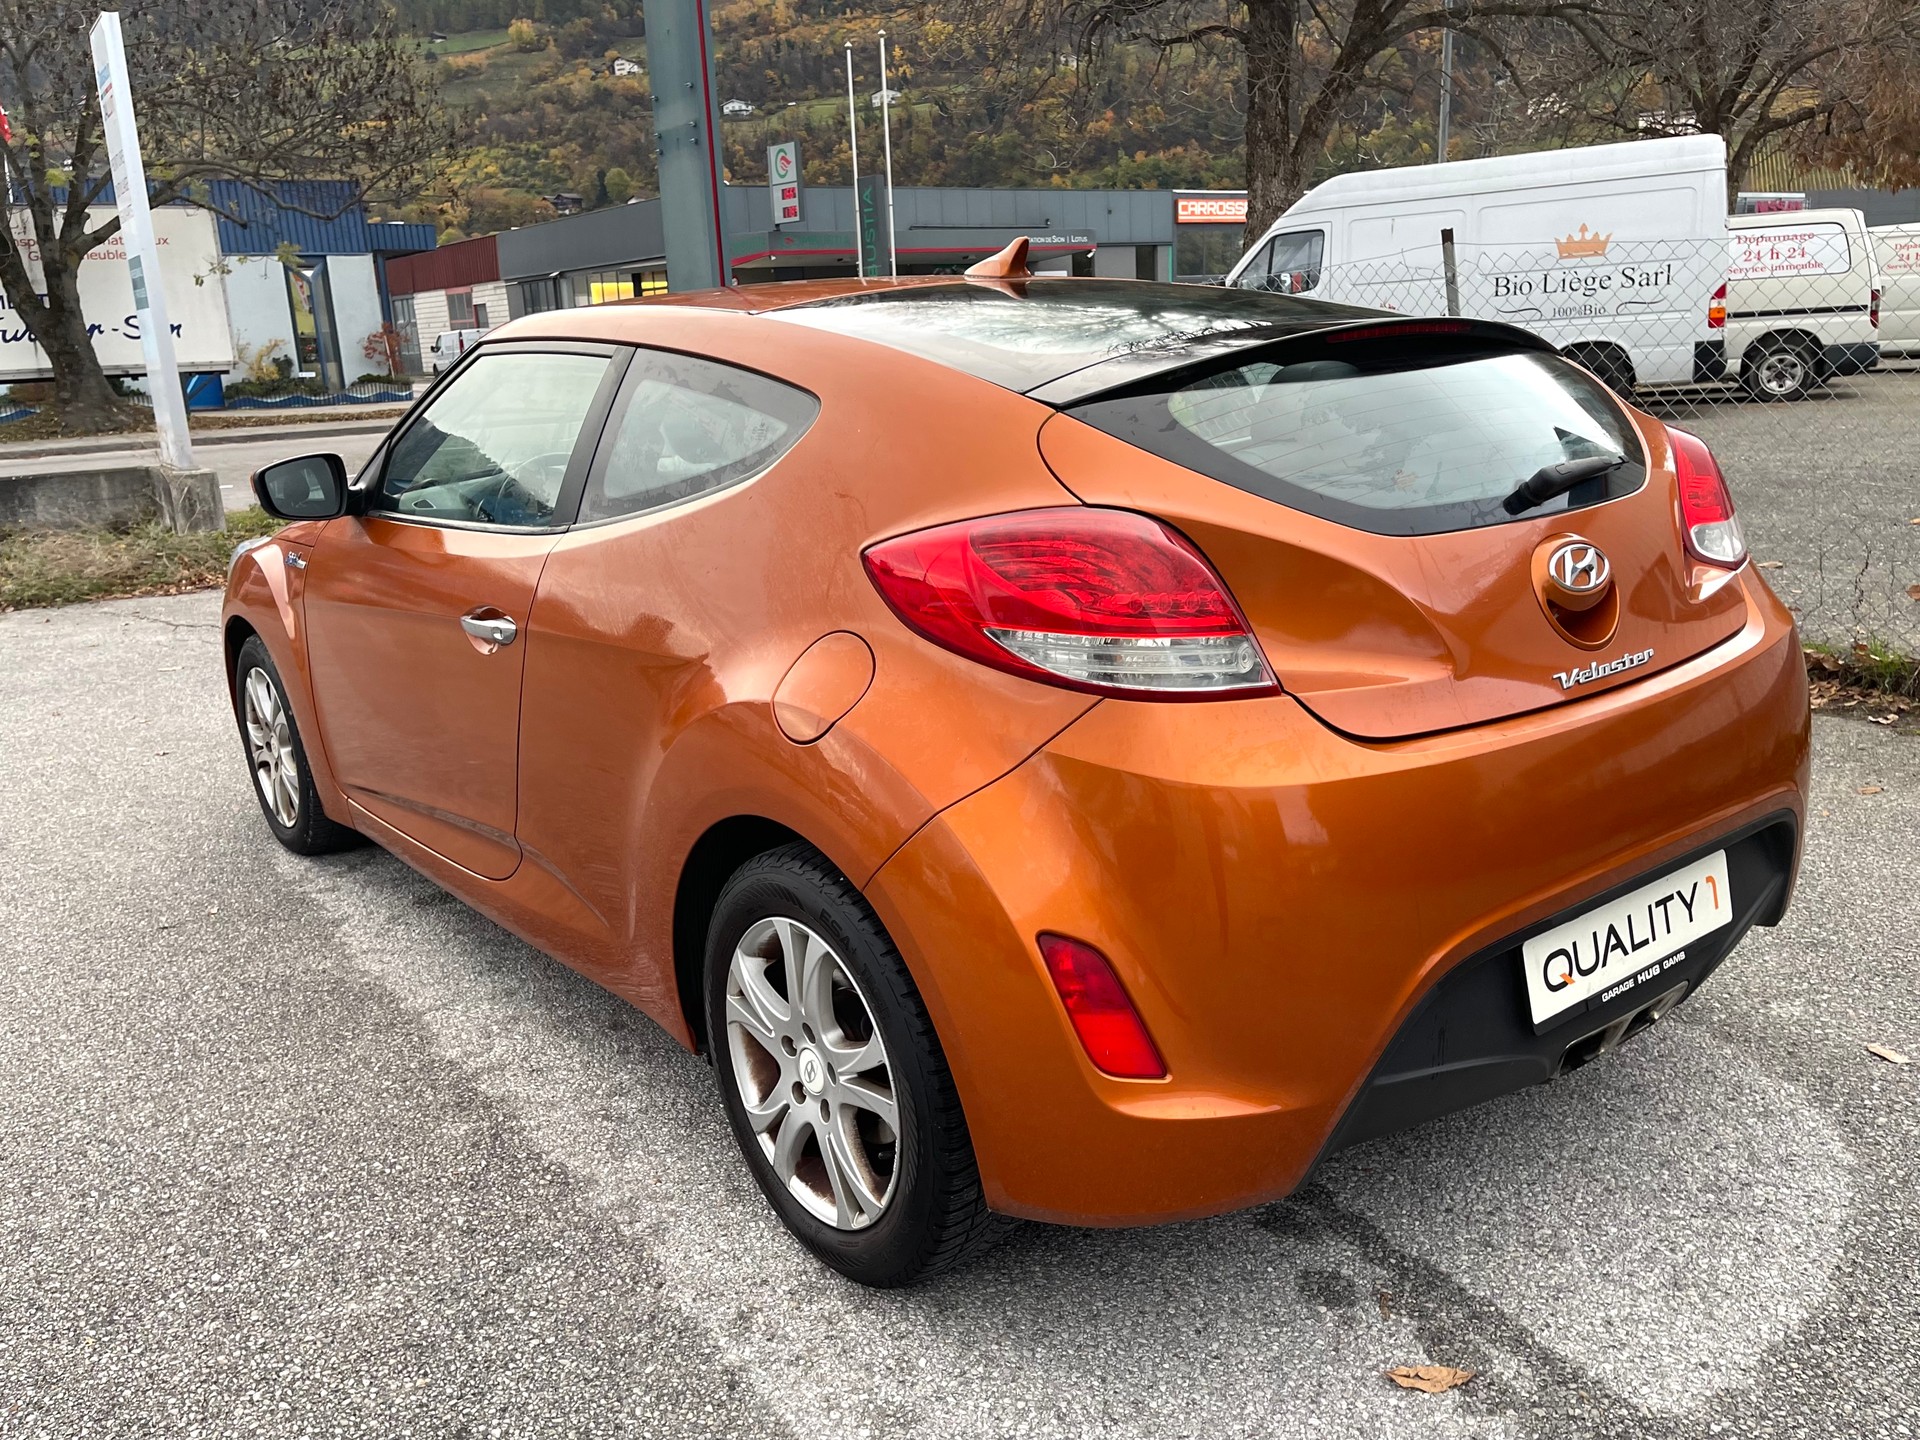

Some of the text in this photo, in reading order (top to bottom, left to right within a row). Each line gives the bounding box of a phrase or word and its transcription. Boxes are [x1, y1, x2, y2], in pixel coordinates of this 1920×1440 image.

[1743, 245, 1807, 263] 24 h 24
[1493, 263, 1673, 298] Bio Liège Sarl
[1551, 648, 1655, 689] Veloster
[1543, 875, 1719, 993] QUALITY 1
[1601, 951, 1686, 1003] GARAGE HUG GAMS
